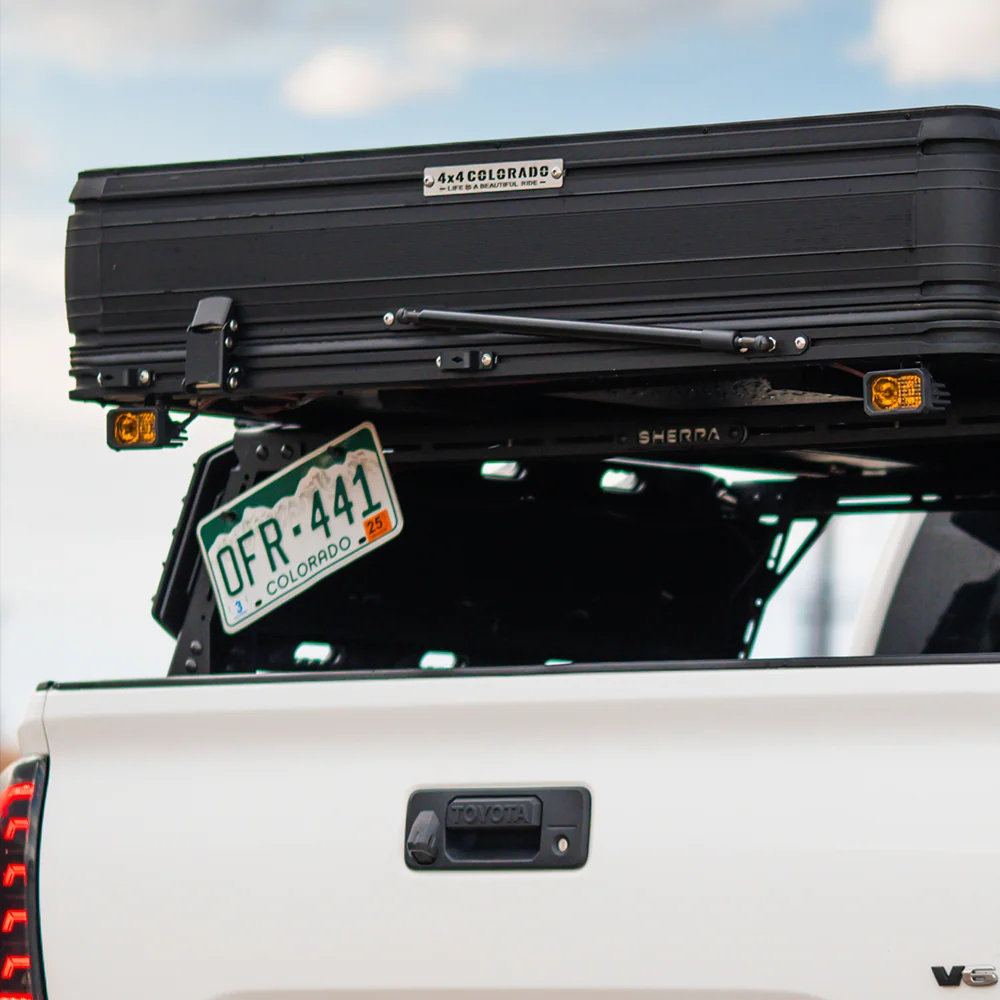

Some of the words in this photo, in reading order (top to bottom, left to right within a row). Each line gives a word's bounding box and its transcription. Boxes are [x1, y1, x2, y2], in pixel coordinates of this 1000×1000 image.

[447, 183, 464, 191] LIFE
[480, 181, 518, 189] BEAUTIFUL
[521, 179, 538, 187] RIDE
[639, 427, 720, 444] SHERPA
[367, 516, 383, 535] 25
[266, 536, 352, 595] COLORADO
[234, 600, 243, 613] 3
[451, 804, 529, 825] TOYOTA
[931, 965, 998, 987] V6
